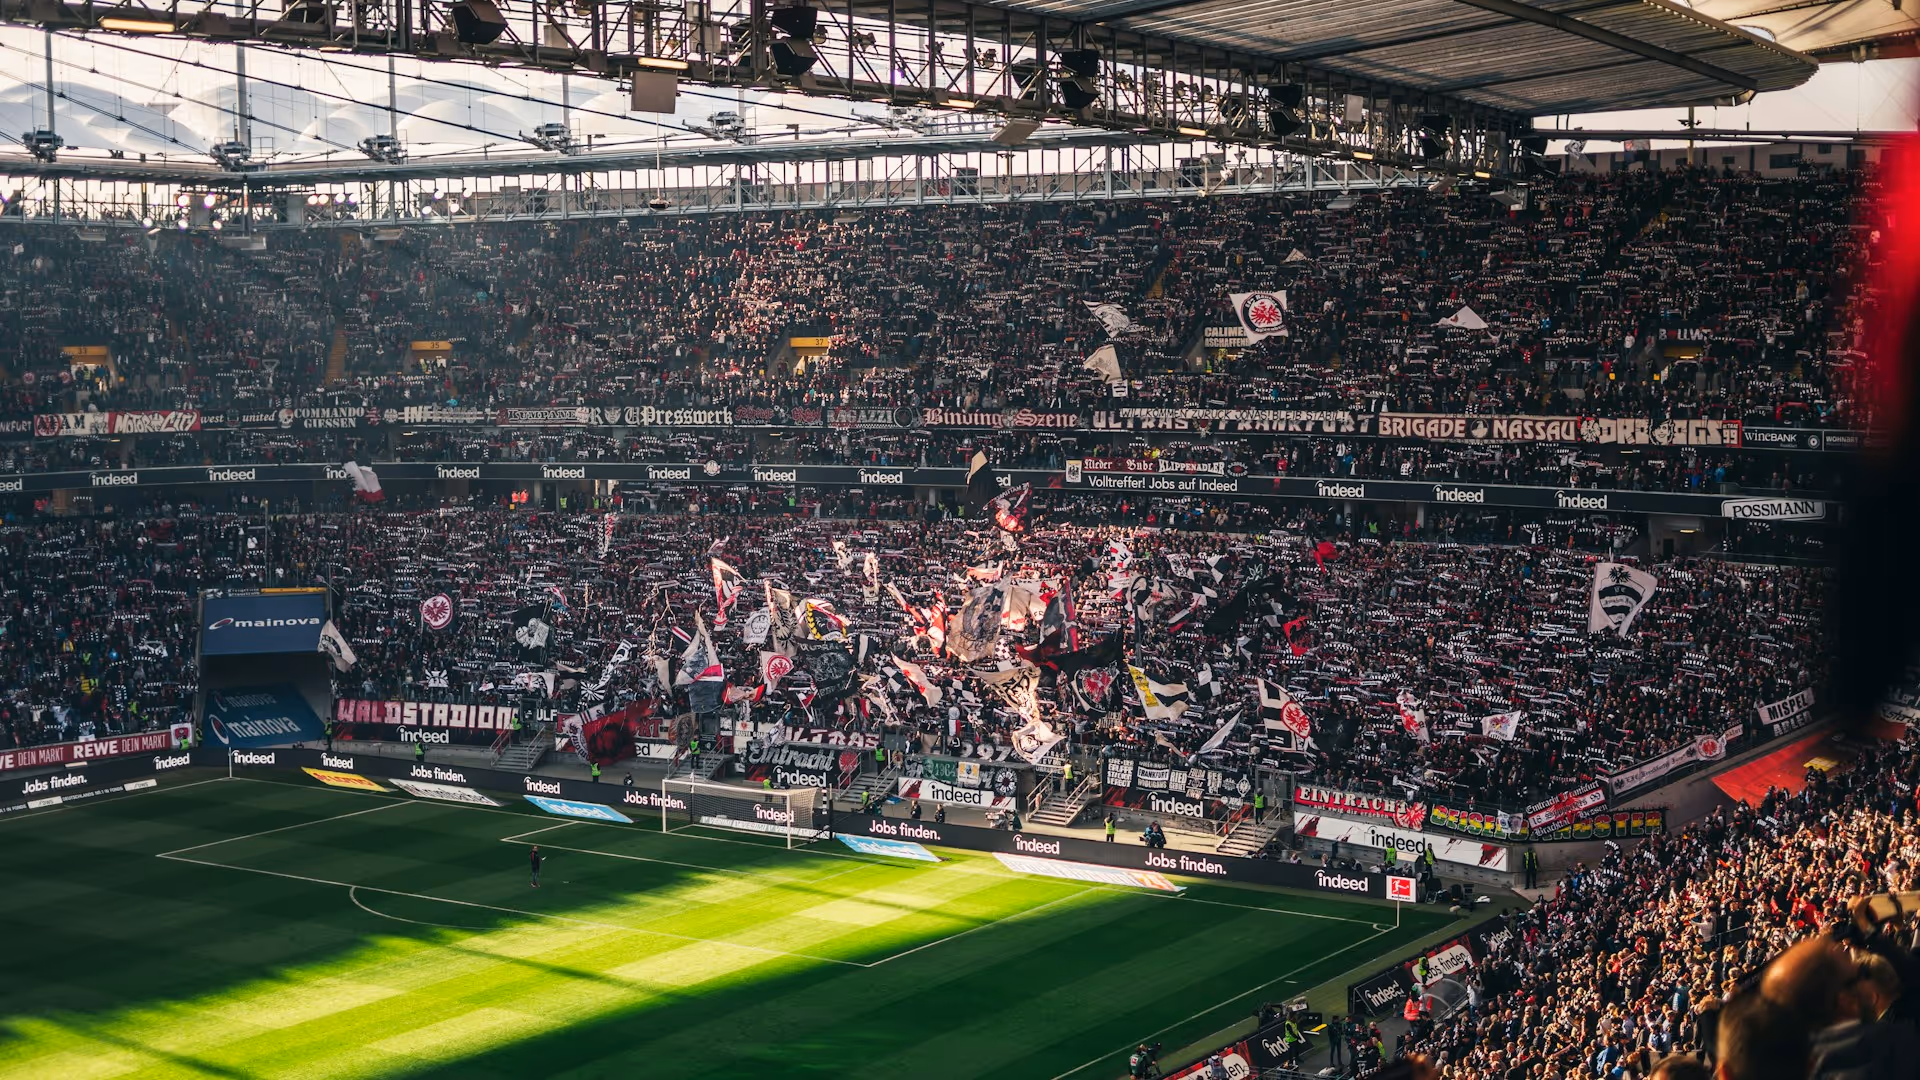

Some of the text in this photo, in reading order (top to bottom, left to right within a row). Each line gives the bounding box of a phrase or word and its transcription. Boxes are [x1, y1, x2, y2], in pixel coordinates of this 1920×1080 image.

[1204, 326, 1247, 337] CALIME
[815, 338, 824, 346] 37
[157, 411, 198, 433] CITY
[200, 409, 278, 424] west united
[293, 407, 365, 419] COMMANDO
[640, 405, 734, 426] Presswerk
[826, 409, 893, 423] RAGAZZI
[1015, 408, 1079, 428] Szene
[1120, 408, 1188, 420] WILLKOMMEN
[303, 417, 356, 429] GIESSEN
[1378, 417, 1576, 442] BRIGADE NASSAU
[1722, 429, 1738, 444] 99
[205, 467, 256, 482] indeed
[435, 464, 480, 479] indeed
[540, 464, 585, 479] indeed
[645, 465, 691, 480] indeed
[750, 465, 797, 482] indeed
[1158, 458, 1225, 475] KLIPPENADLER
[89, 471, 138, 486] indeed
[857, 469, 903, 484] indeed
[1088, 475, 1238, 492] Volltreffer! Jobs auf Indeed
[1315, 480, 1365, 498] indeed
[1433, 484, 1485, 503] indeed
[1554, 490, 1608, 510] indeed
[1732, 501, 1817, 518] POSSMANN
[234, 617, 320, 628] mainova
[1767, 693, 1809, 721] MISPEL
[225, 715, 302, 738] mainova
[396, 725, 450, 744] indeed
[18, 751, 37, 767] DEIN
[38, 747, 65, 763] MARKT
[73, 740, 119, 759] REWE
[121, 738, 140, 753] DEIN
[141, 734, 166, 750] MARKT
[231, 750, 276, 765] indeed
[748, 744, 836, 773] Eintracht
[153, 753, 190, 770] indeed
[321, 753, 354, 770] indeed
[411, 765, 468, 783] Jobs finden.
[773, 765, 827, 788] indeed
[1138, 767, 1169, 779] FRANKFURT
[1170, 771, 1188, 783] RIED
[21, 773, 88, 794] Jobs finden.
[524, 776, 561, 795] indeed
[927, 781, 982, 804] indeed
[623, 790, 688, 810] Jobs finden.
[1147, 791, 1204, 818] indeed
[1299, 785, 1408, 814] EINTRACHT
[1525, 780, 1600, 815] Eintracht Frankfurt
[1589, 791, 1601, 802] 99
[753, 803, 795, 823] indeed
[869, 819, 942, 840] Jobs finden.
[1013, 834, 1060, 855] indeed
[1365, 824, 1426, 855] indeed
[1145, 852, 1177, 870] Jobs
[1179, 855, 1227, 876] finden.
[1314, 869, 1369, 892] indeed
[1480, 925, 1514, 948] ideed
[1364, 980, 1405, 1007] indeed
[1261, 1031, 1306, 1058] indd
